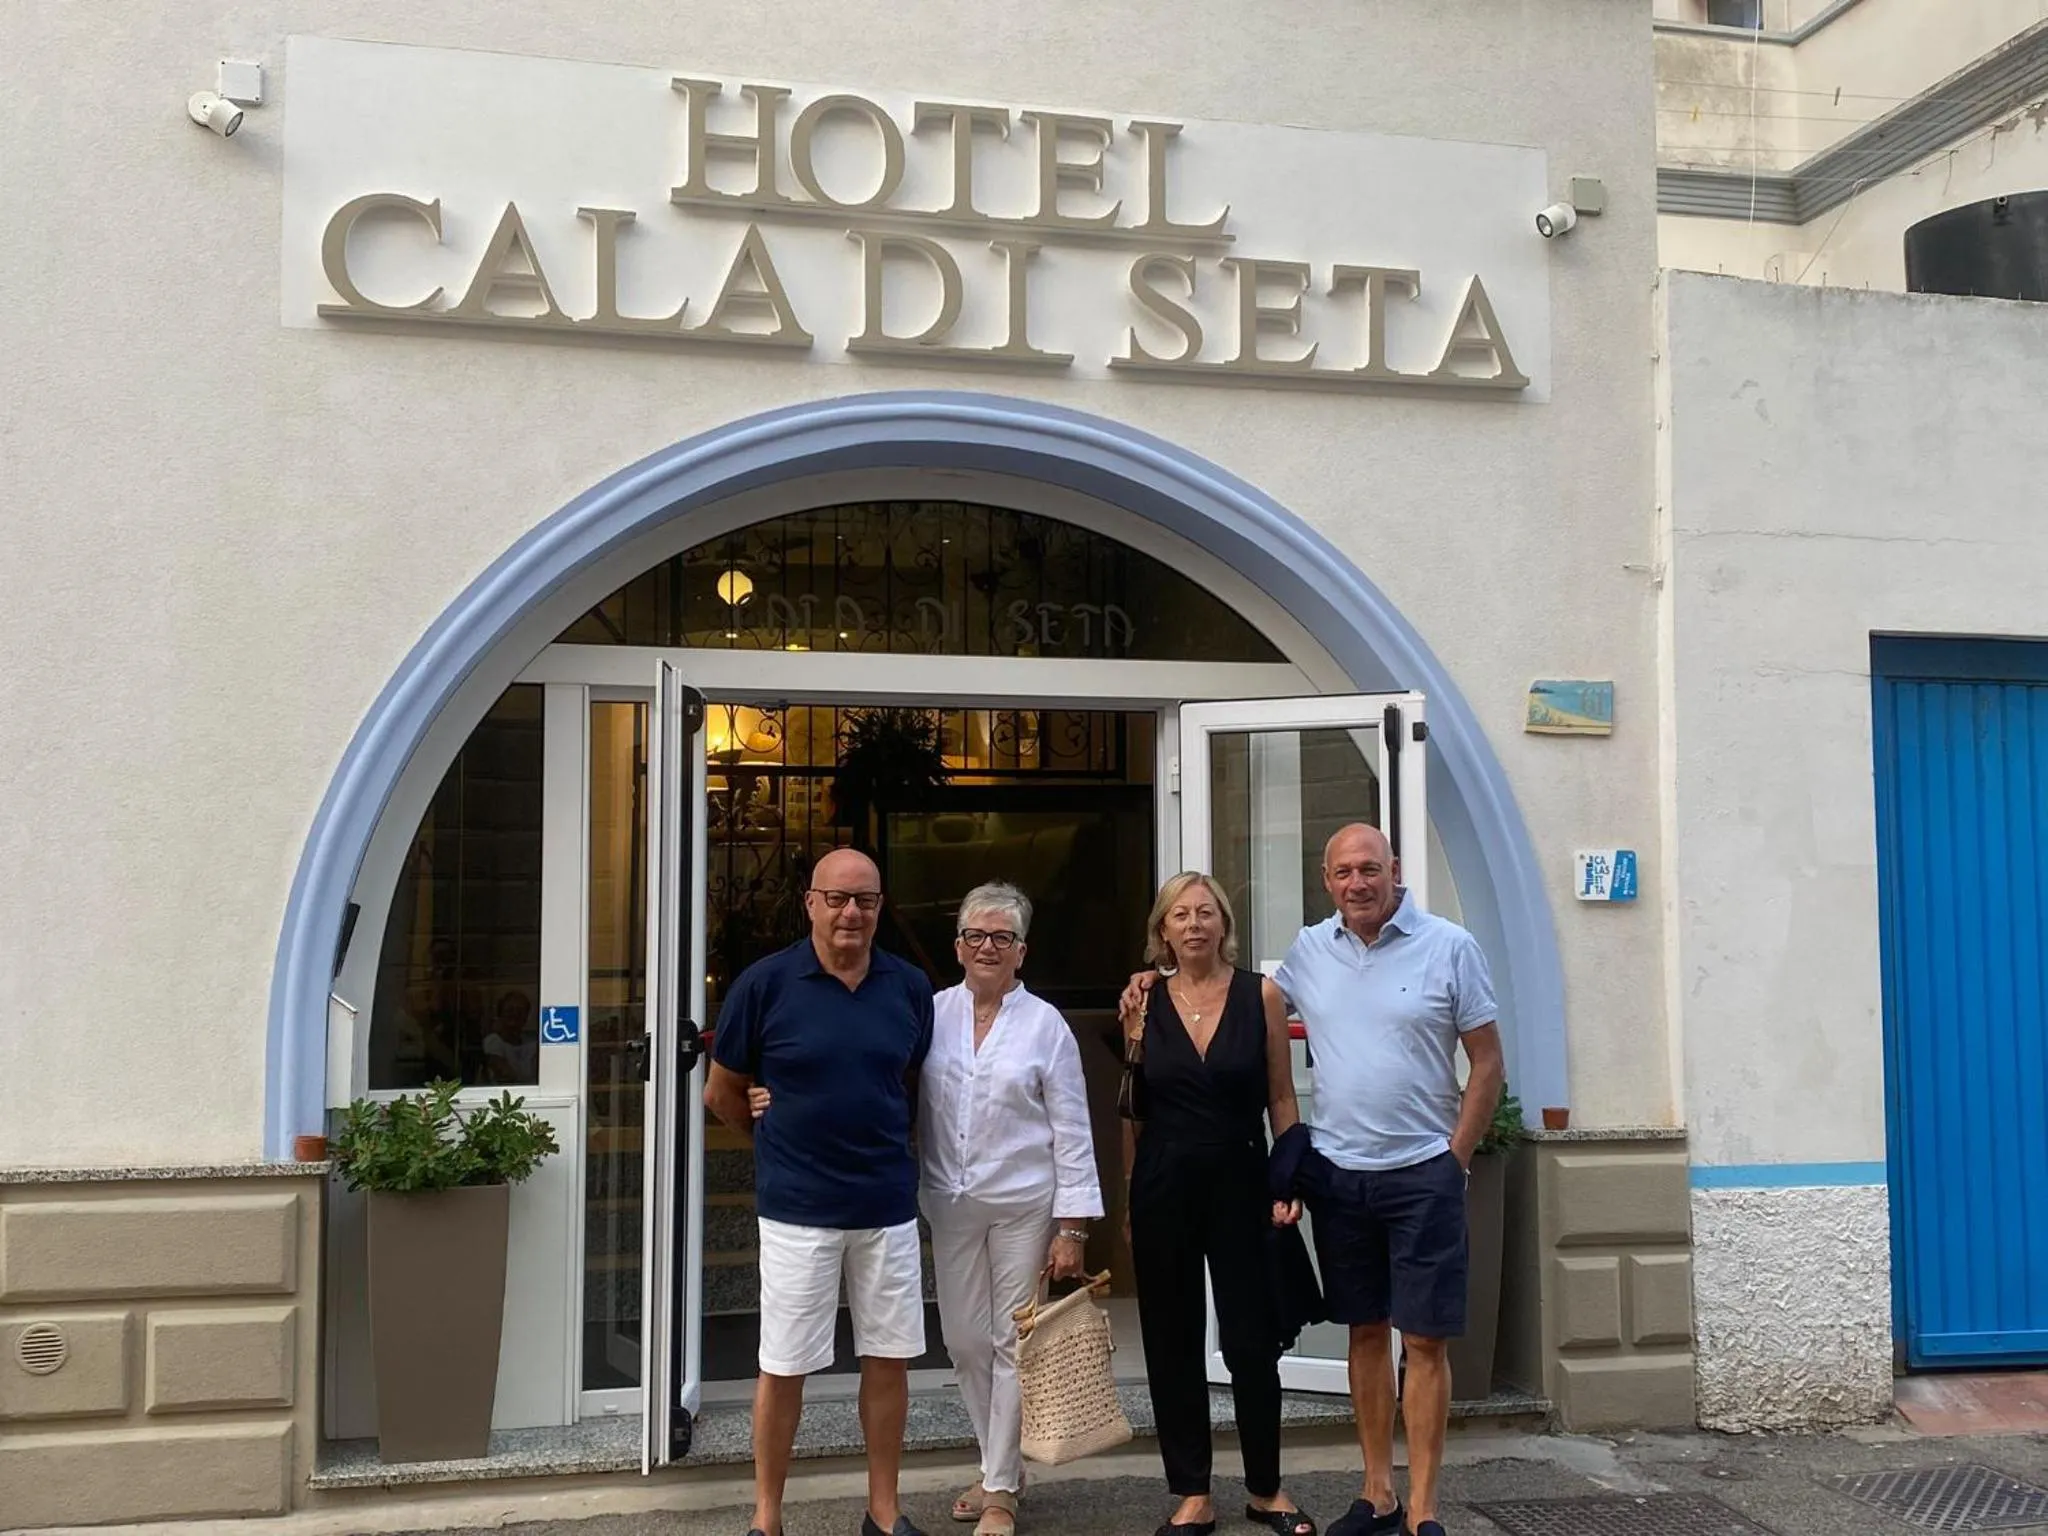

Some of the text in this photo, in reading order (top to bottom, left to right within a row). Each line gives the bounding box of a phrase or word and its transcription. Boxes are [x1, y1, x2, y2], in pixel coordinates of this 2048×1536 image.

[671, 77, 1236, 243] HOTEL
[317, 192, 1530, 389] CALA DI SETA
[1006, 599, 1136, 649] SETA
